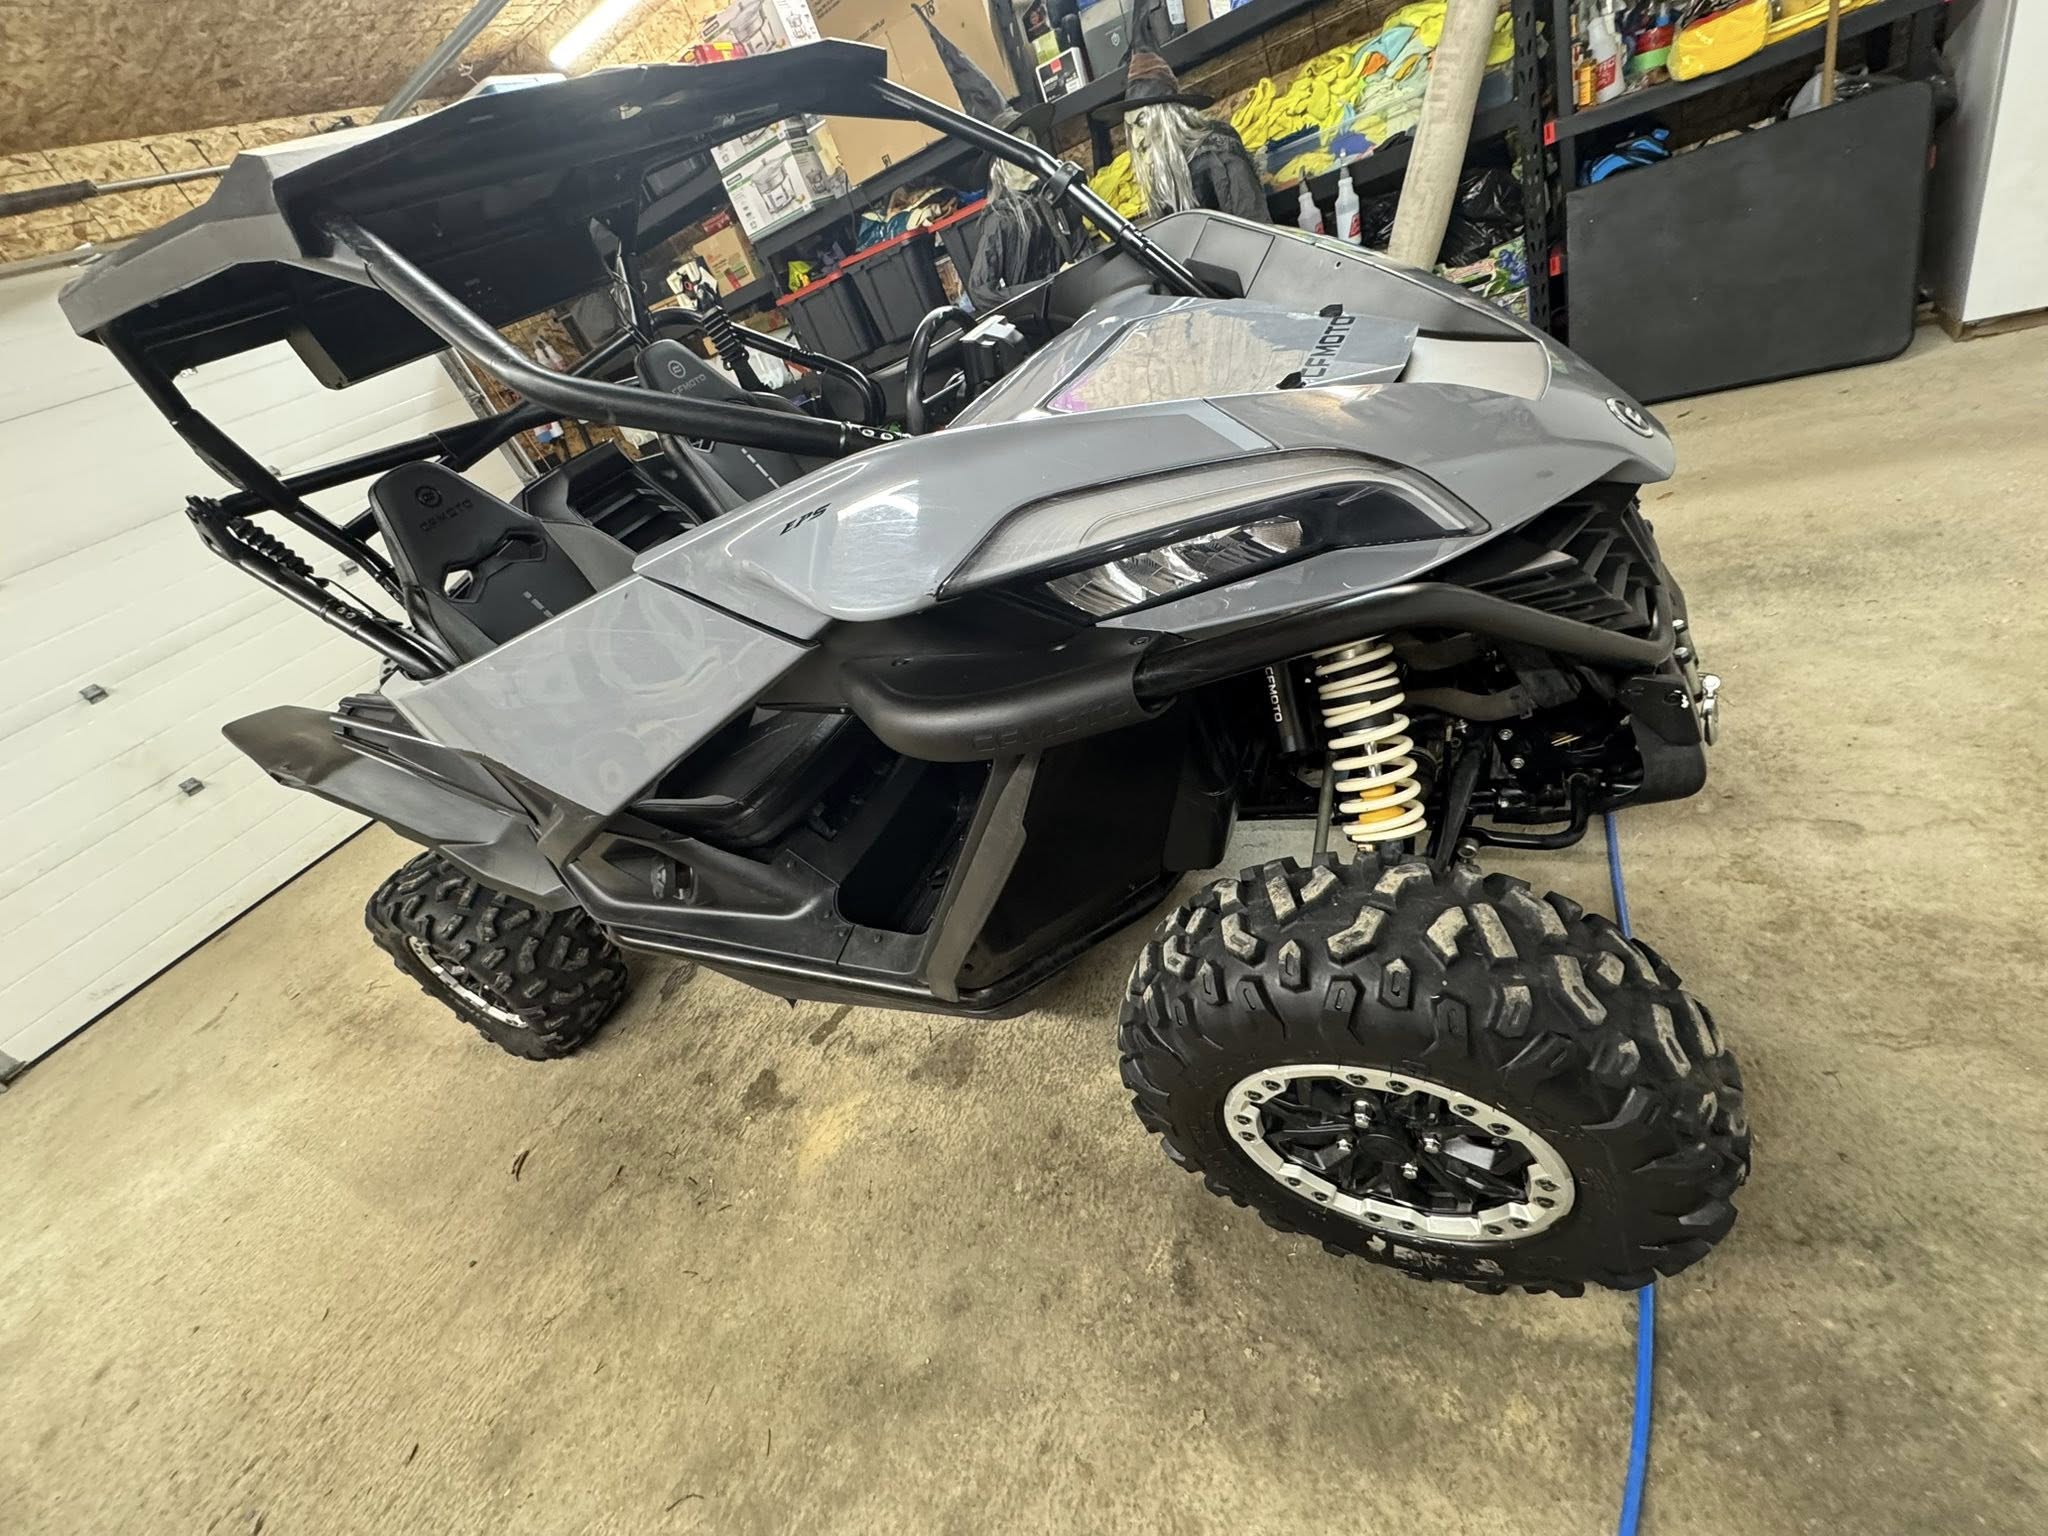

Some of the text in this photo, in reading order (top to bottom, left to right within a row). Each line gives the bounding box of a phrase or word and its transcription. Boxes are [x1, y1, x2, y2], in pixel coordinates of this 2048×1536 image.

[1300, 316, 1356, 377] CFMOTO
[779, 502, 832, 536] EPS
[1265, 666, 1283, 722] CFMOTO
